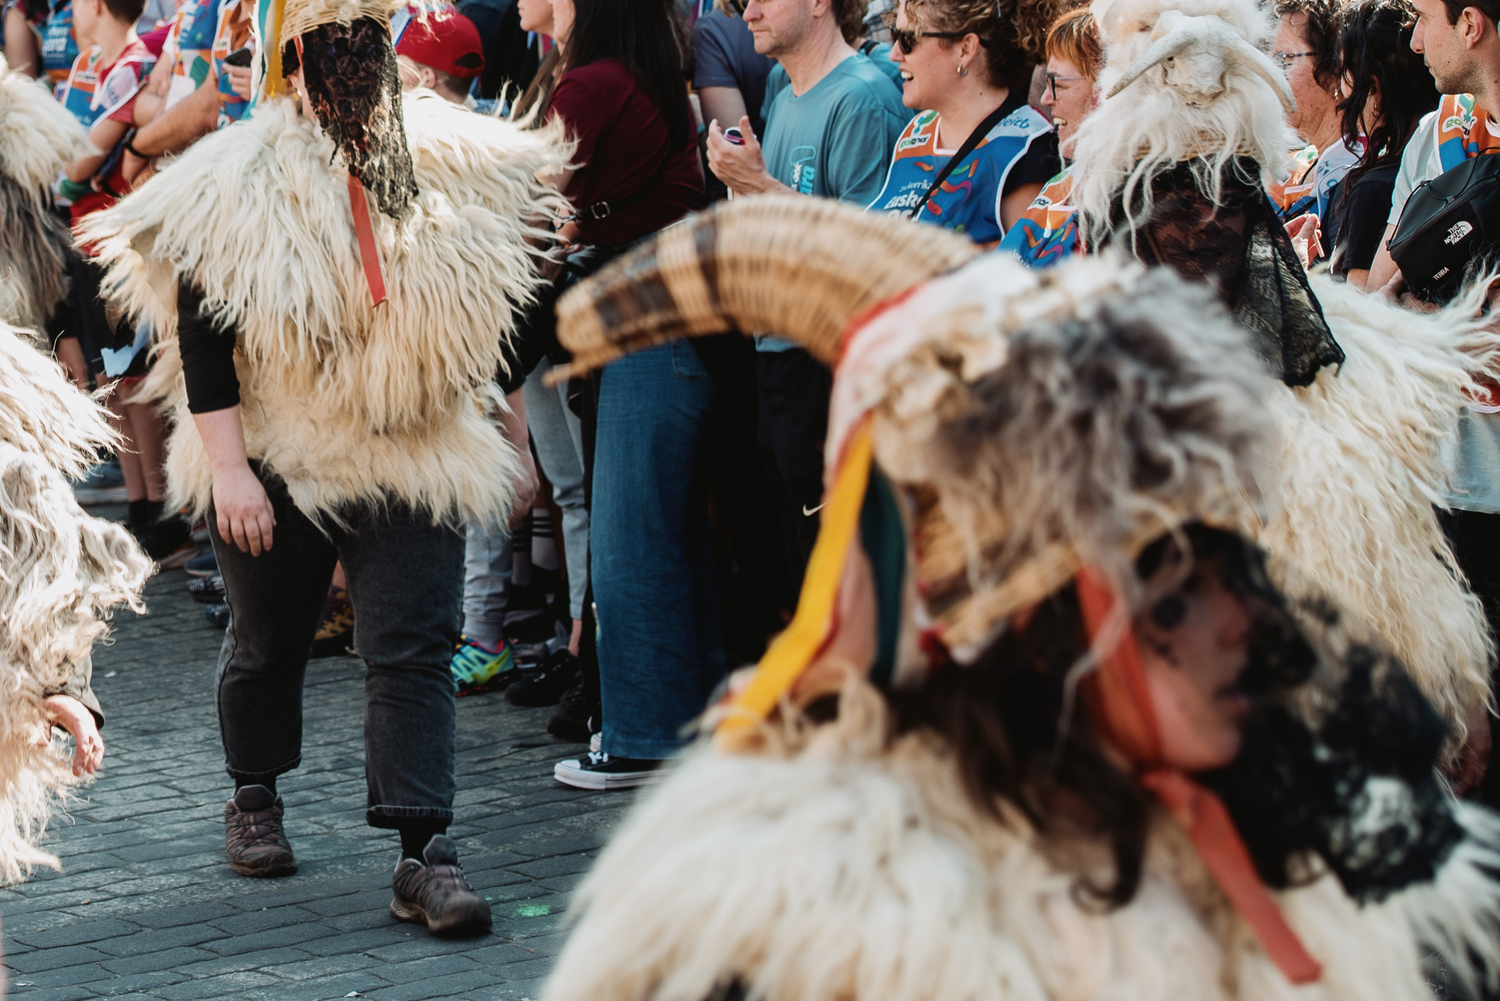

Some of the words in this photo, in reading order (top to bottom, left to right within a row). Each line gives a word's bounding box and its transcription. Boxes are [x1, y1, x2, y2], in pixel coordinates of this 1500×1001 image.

[1447, 223, 1459, 234] THE
[1444, 228, 1463, 245] NORTH
[1451, 232, 1466, 245] FACE
[1433, 266, 1450, 281] TERRA
